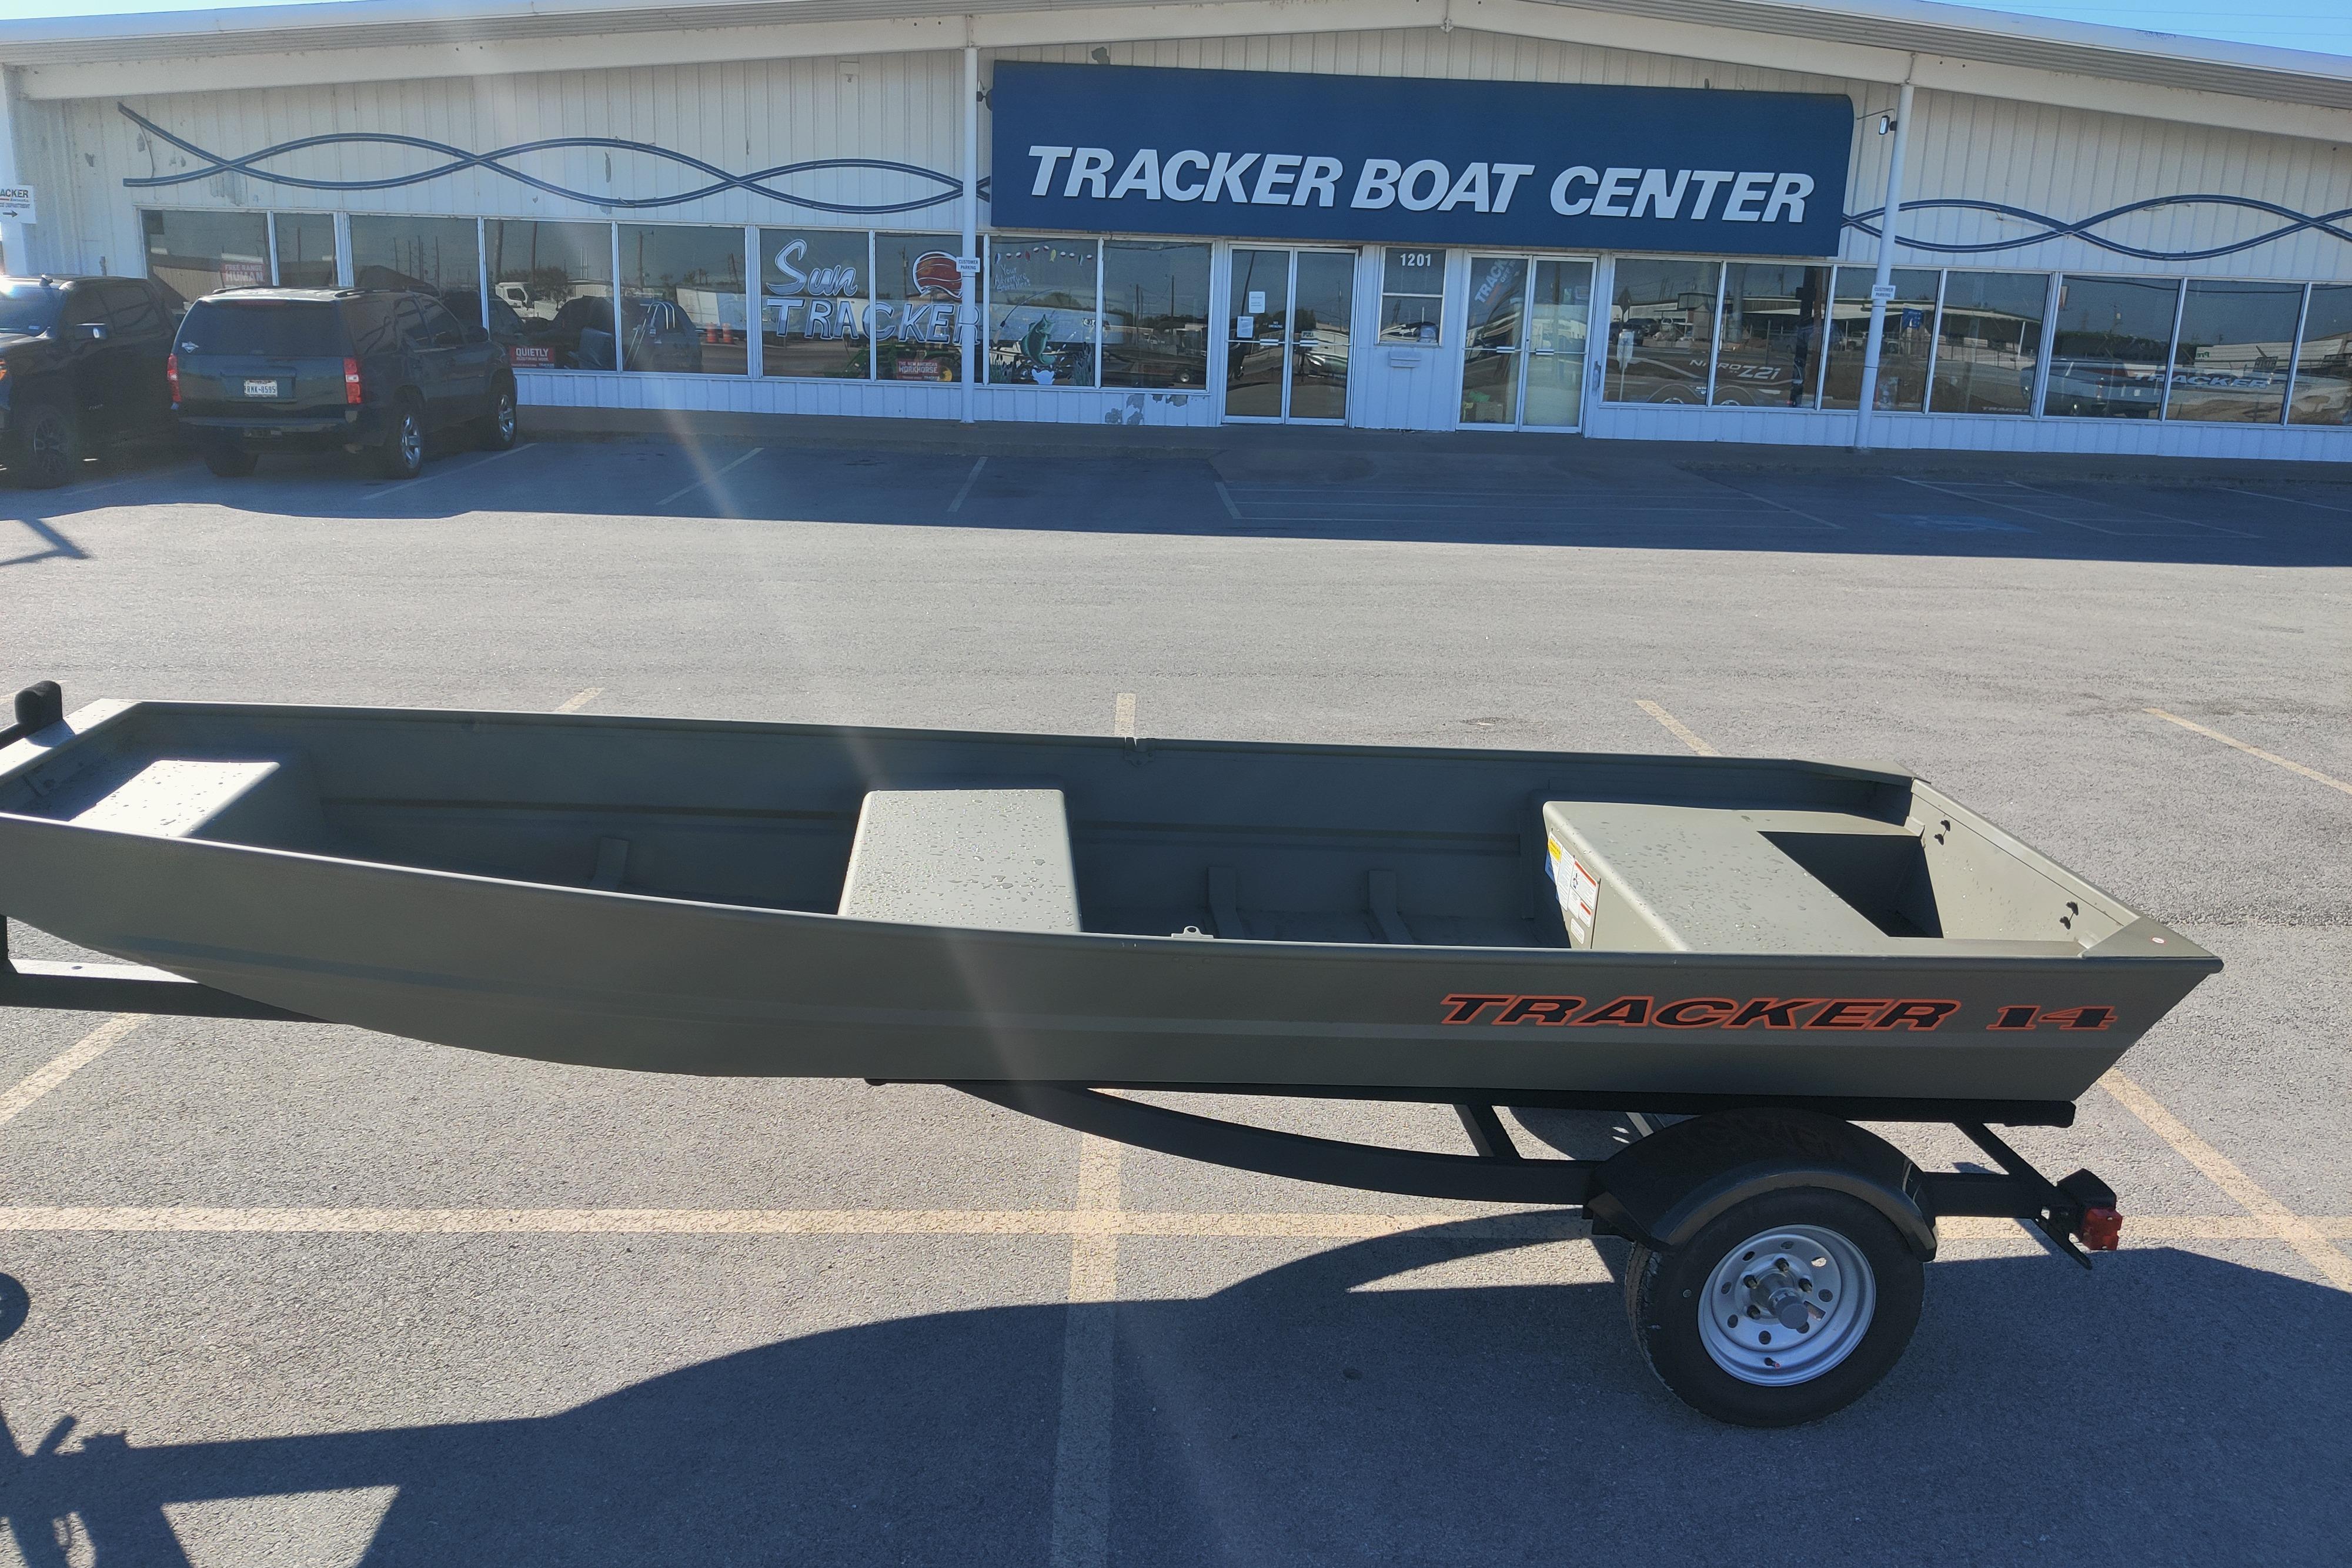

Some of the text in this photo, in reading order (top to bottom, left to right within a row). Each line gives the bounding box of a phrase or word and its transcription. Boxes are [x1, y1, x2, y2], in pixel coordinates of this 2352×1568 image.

[1028, 145, 1815, 223] TRACKER BOAT CENTER
[1400, 253, 1431, 267] 1201
[766, 239, 858, 296] Sun
[1000, 264, 1017, 275] Your
[225, 271, 264, 282] HUMAN
[516, 347, 549, 357] QUIETLY
[898, 366, 939, 374] WORKHORSE
[1689, 359, 1781, 380] NIRO Z21
[1440, 993, 2118, 1031] TRACKER 14
